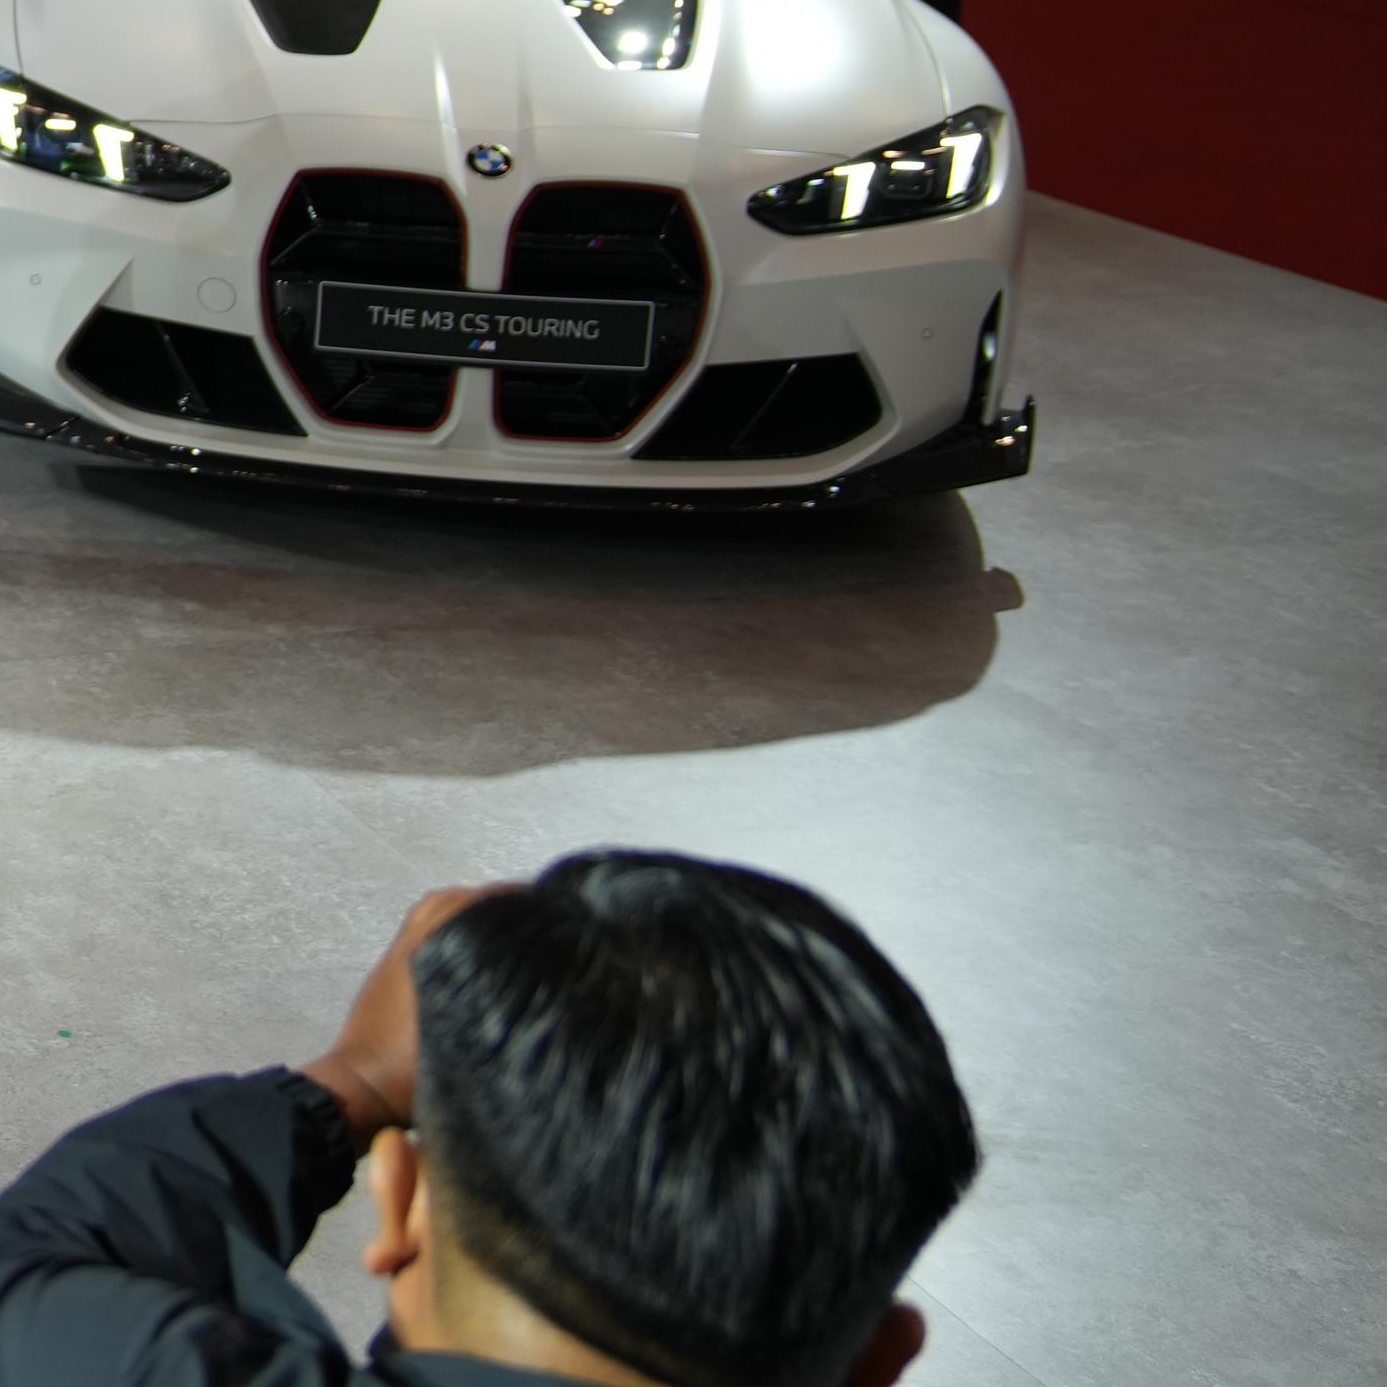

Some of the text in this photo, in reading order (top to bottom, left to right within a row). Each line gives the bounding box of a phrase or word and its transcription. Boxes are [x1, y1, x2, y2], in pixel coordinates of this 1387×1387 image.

[367, 305, 601, 341] THE M3 CS TOURING
